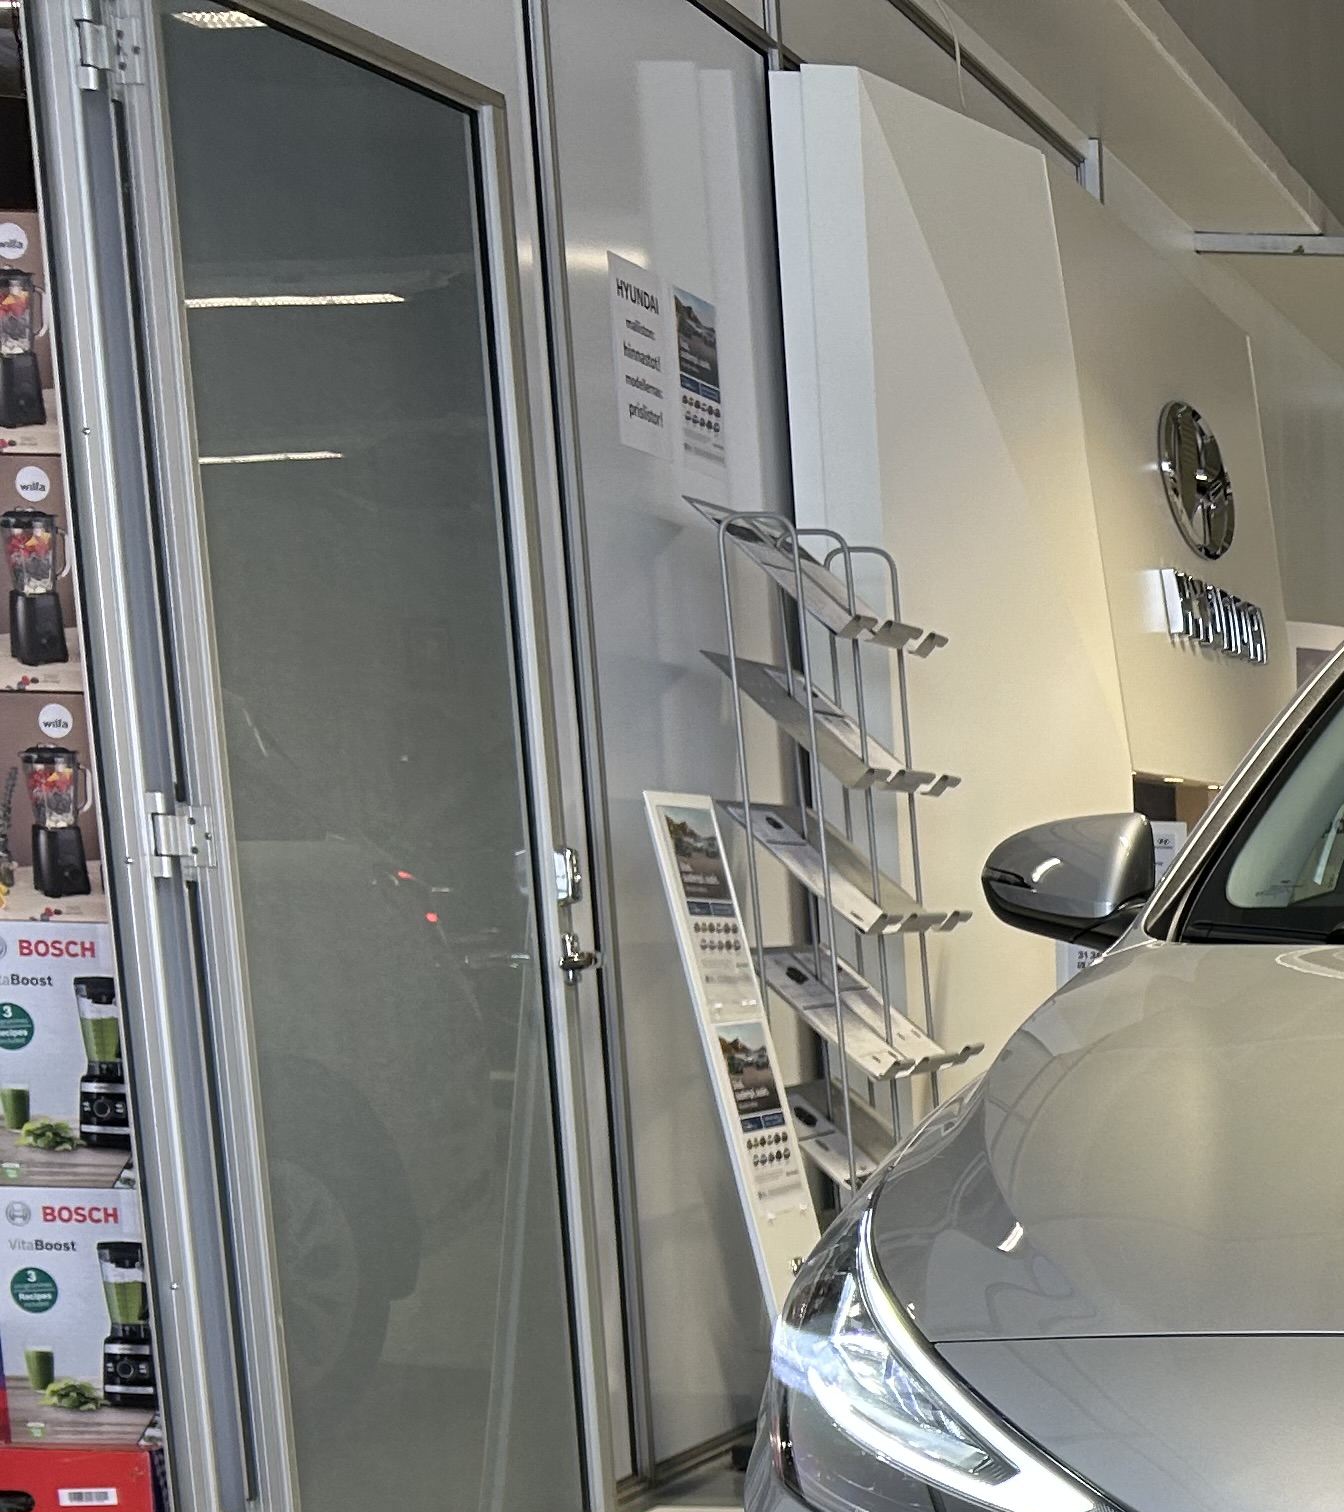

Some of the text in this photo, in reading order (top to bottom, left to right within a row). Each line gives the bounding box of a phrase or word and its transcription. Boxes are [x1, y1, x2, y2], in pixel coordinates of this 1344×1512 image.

[616, 278, 660, 315] HYUNDAI
[18, 939, 96, 958] BOSCH
[3, 1005, 13, 1018] 3
[41, 1205, 119, 1224] BOSCH
[8, 1239, 77, 1252] VitaBoost
[26, 1270, 37, 1282] 3
